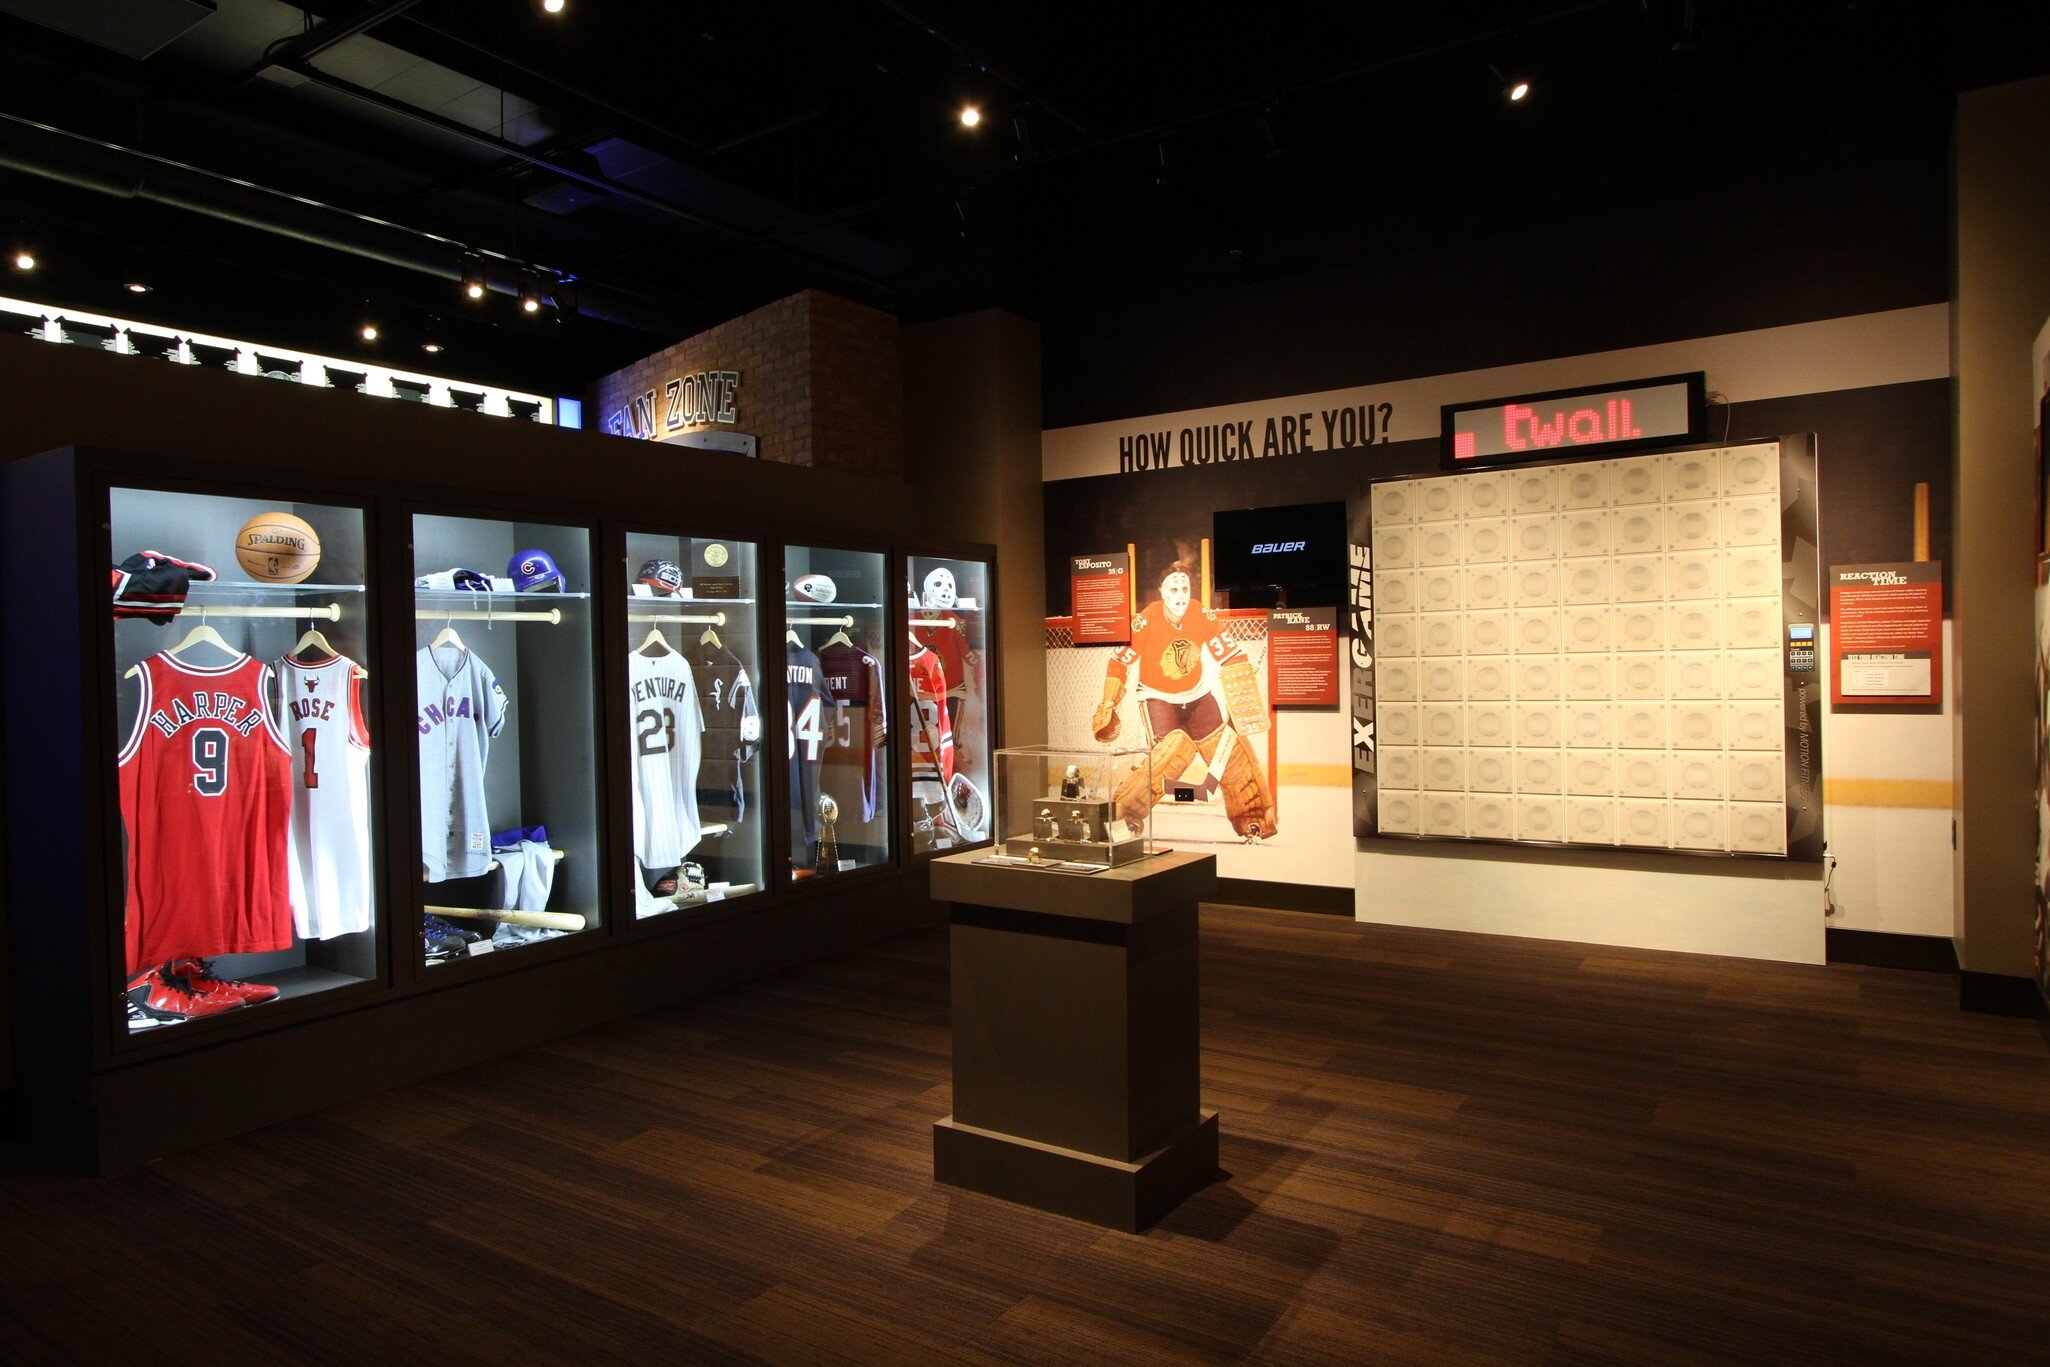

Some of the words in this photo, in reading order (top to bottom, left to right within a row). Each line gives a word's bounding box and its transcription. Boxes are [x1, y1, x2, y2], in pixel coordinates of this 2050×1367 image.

[608, 389, 658, 440] FAN
[666, 371, 738, 429] ZONE
[1119, 431, 1172, 473] HOW
[1180, 420, 1255, 466] QUICK
[1262, 412, 1313, 457] ARE
[1321, 402, 1393, 450] YOU?
[248, 533, 305, 551] SPALDING
[1251, 541, 1306, 554] BAUER
[1075, 558, 1091, 567] TONY
[1078, 561, 1112, 570] ESPOSITO
[1840, 571, 1896, 580] REACTION
[1872, 576, 1907, 586] TIME
[1273, 612, 1303, 620] PATRICK
[1209, 631, 1236, 656] 35
[150, 692, 263, 738] HARPER
[289, 698, 335, 721] ROSE
[1797, 687, 1807, 721] powered
[1798, 722, 1808, 732] by
[302, 728, 318, 789] 1
[1800, 733, 1809, 767] MOTION
[192, 727, 230, 797] 9
